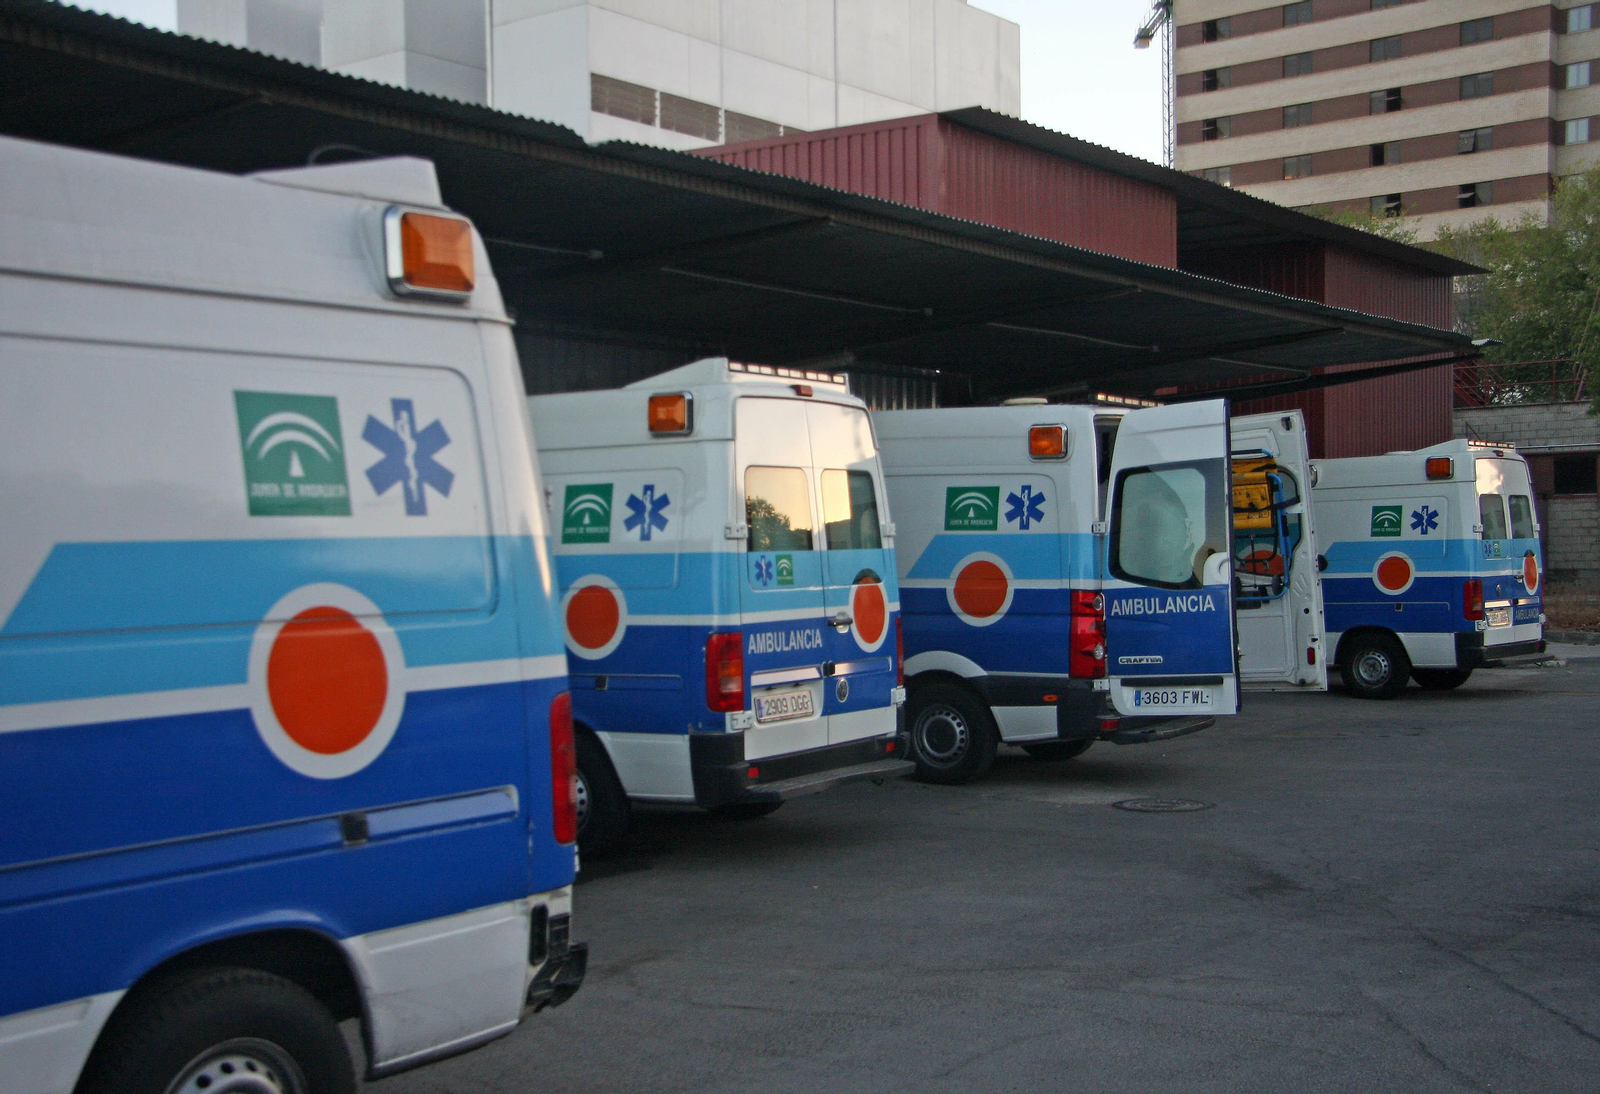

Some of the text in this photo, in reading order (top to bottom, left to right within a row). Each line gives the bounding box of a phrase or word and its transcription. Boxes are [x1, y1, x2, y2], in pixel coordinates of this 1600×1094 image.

[1110, 594, 1216, 616] AMBULANCIA
[748, 629, 823, 655] AMBULANCIA
[765, 694, 810, 716] 2909 DGG
[1144, 690, 1208, 705] 3603 FWL
